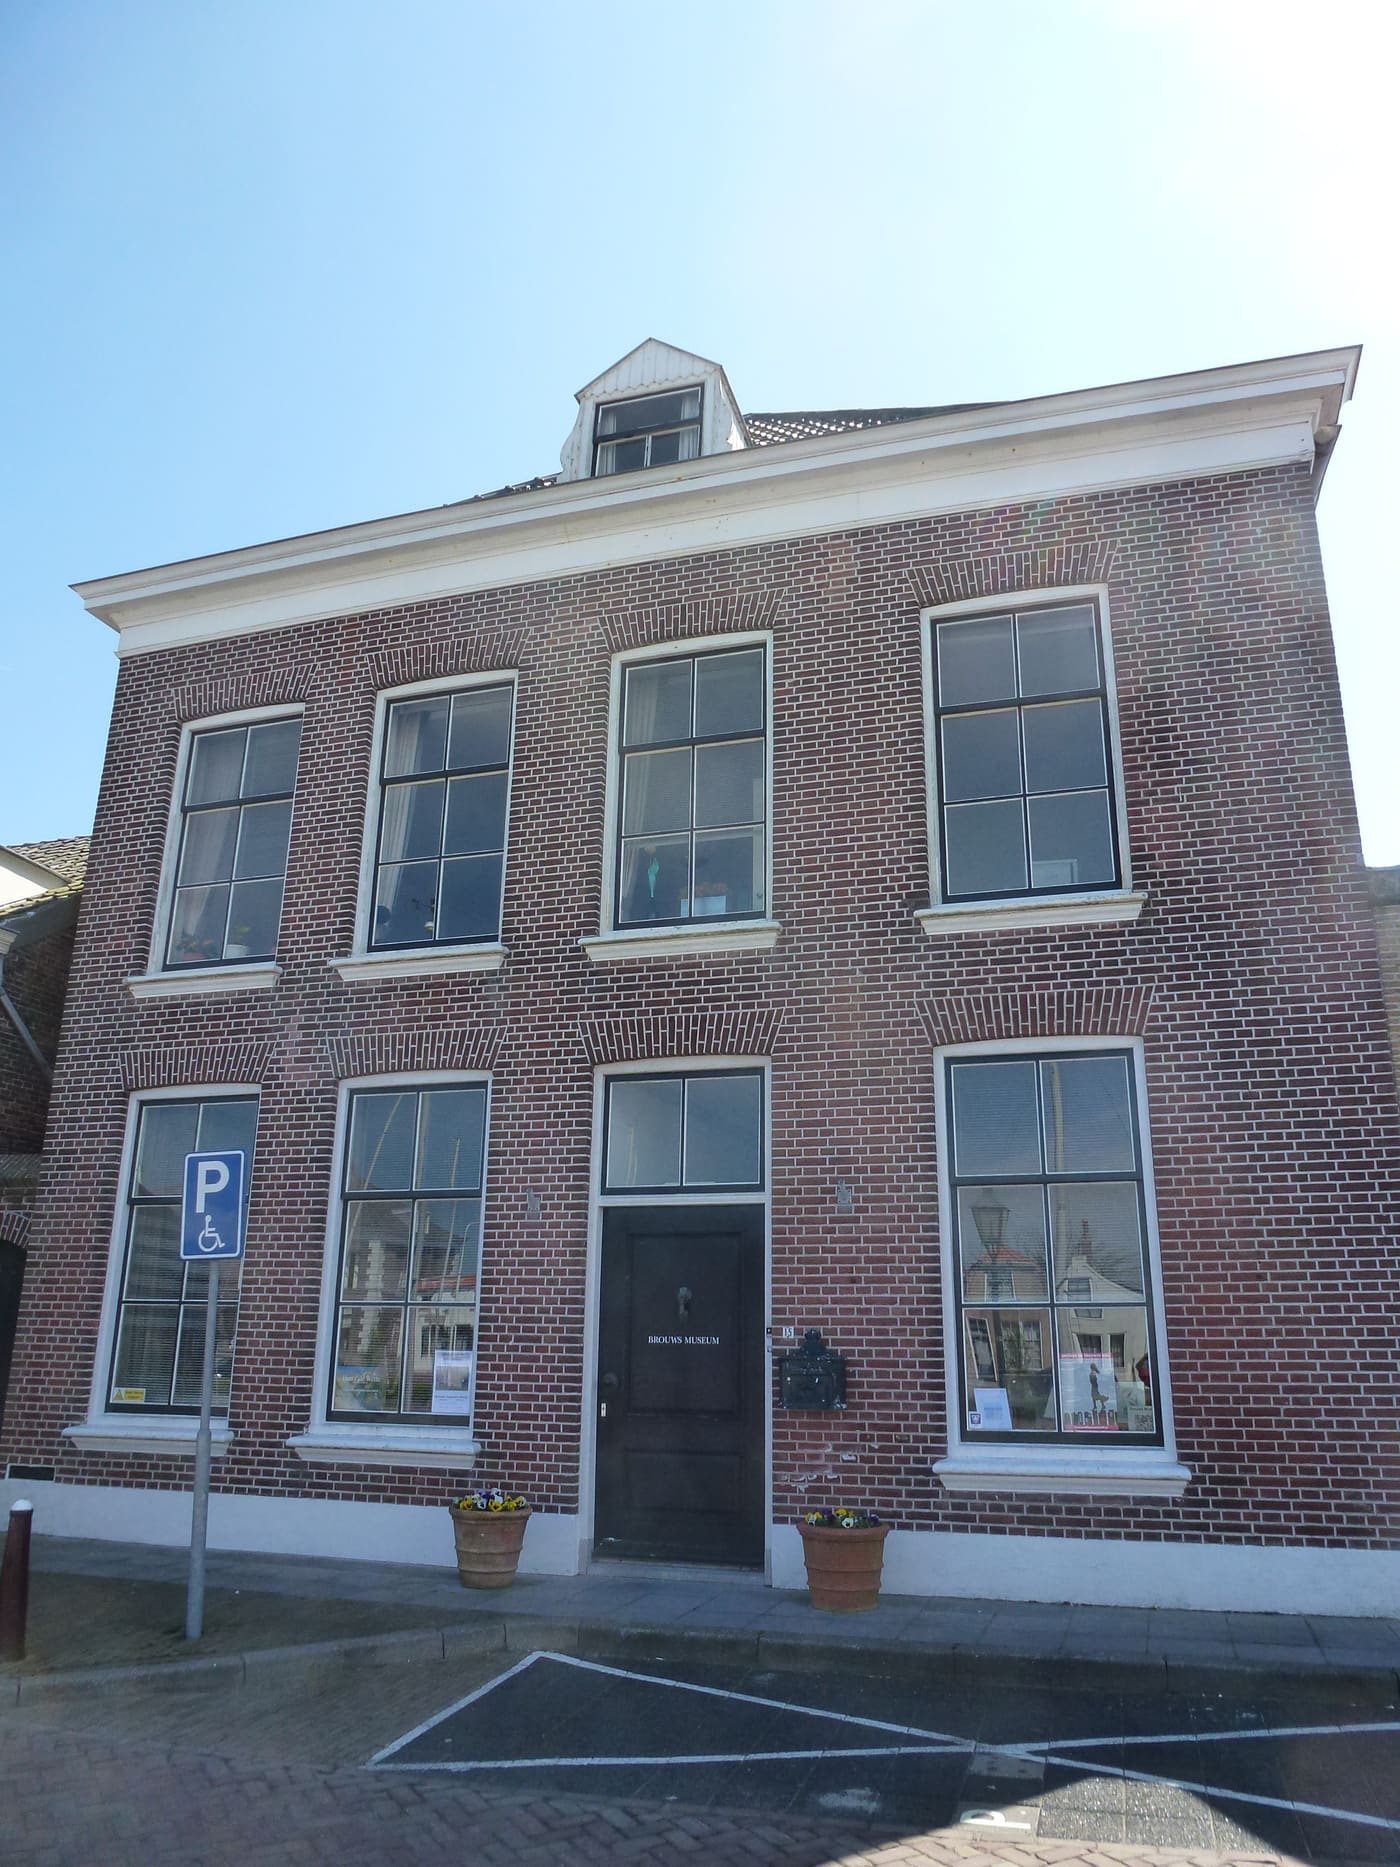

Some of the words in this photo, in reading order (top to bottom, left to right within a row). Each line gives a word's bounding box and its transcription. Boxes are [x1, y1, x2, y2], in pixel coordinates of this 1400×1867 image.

[196, 1161, 230, 1213] P
[784, 1327, 792, 1337] 15
[648, 1335, 683, 1345] BROUWS
[684, 1335, 720, 1345] MUSEUM
